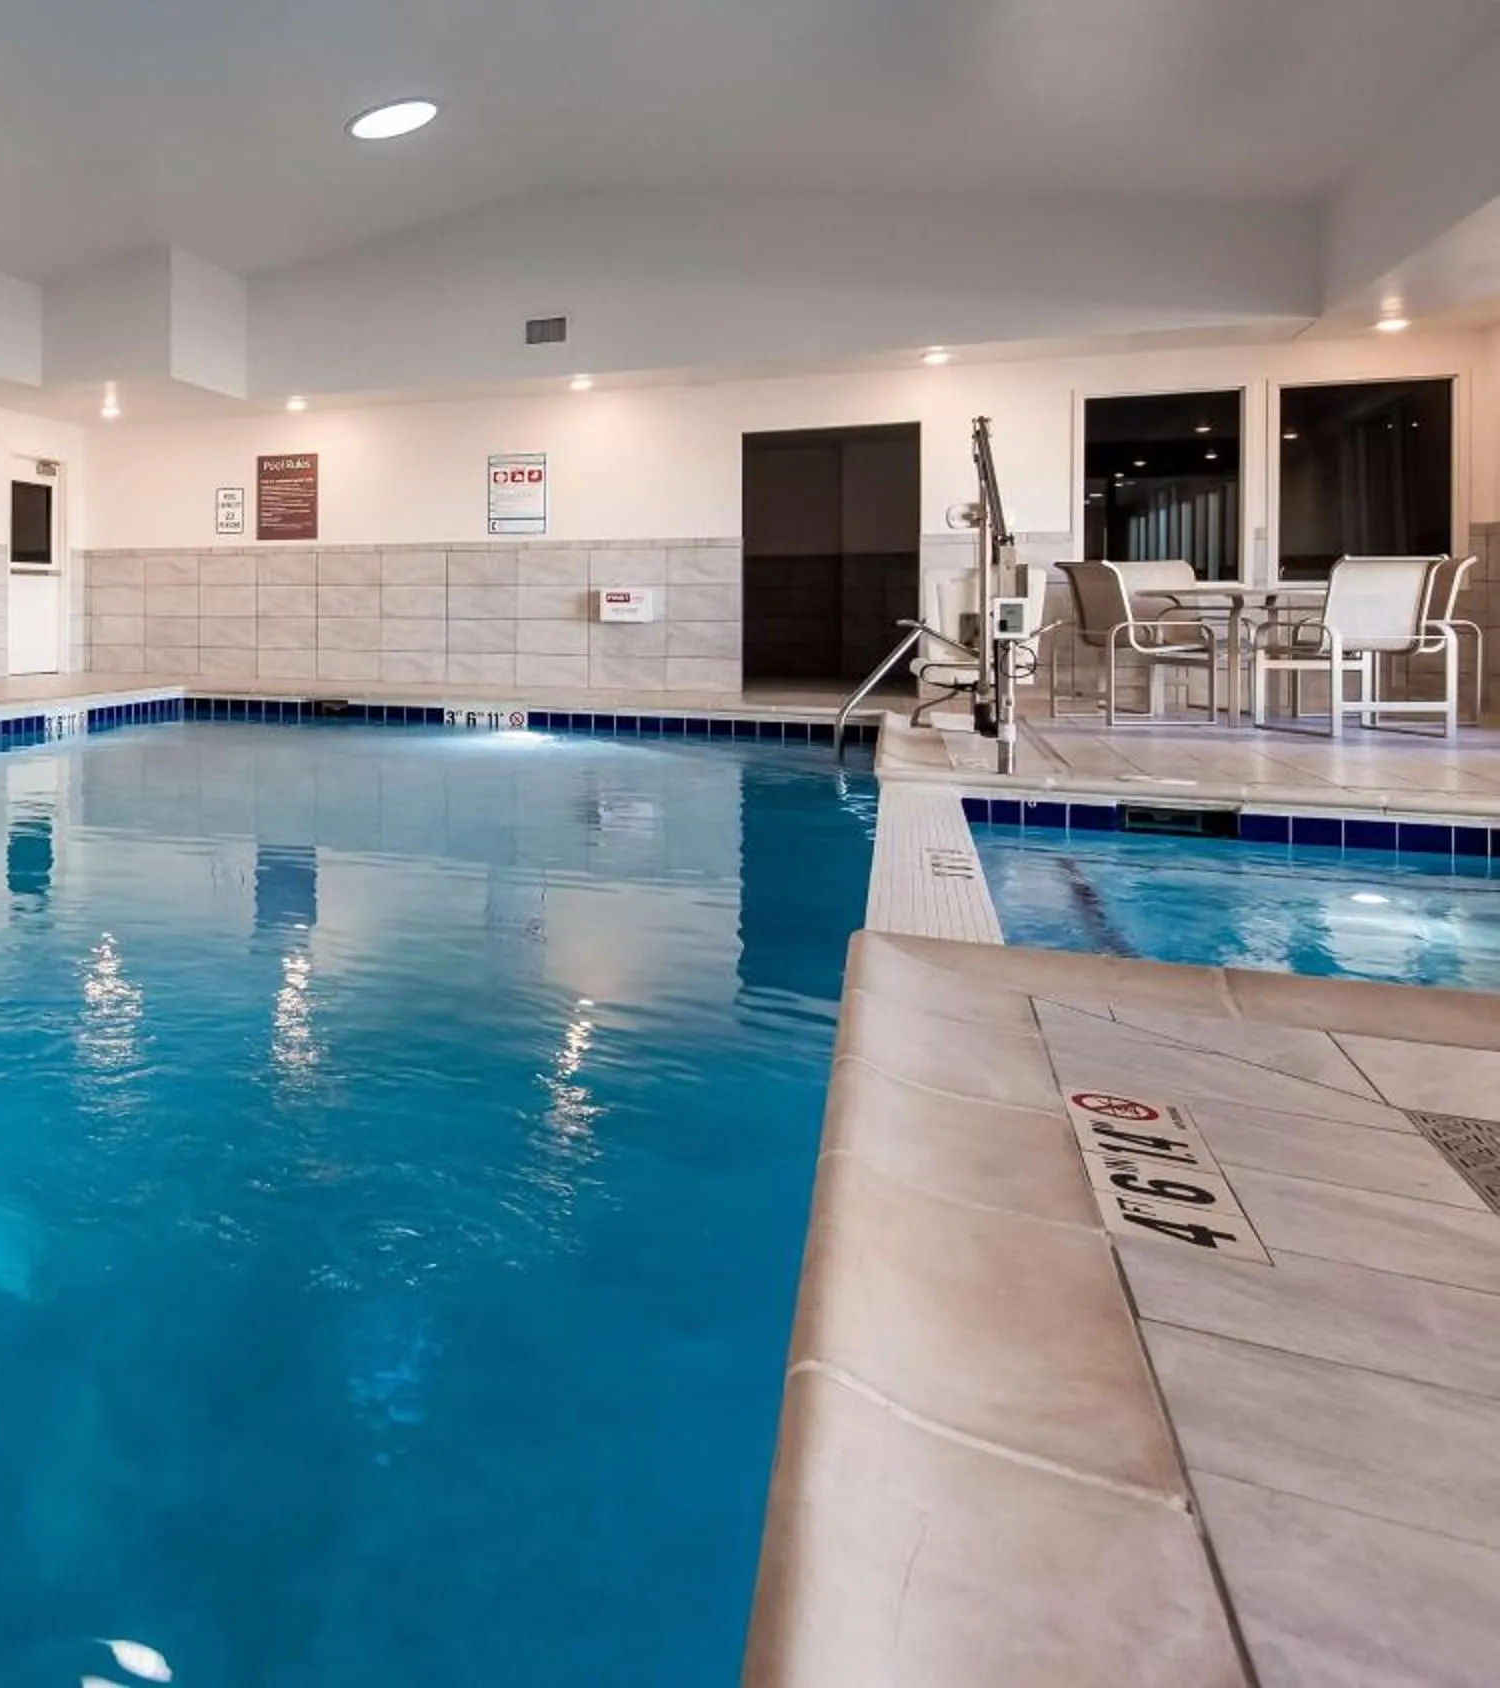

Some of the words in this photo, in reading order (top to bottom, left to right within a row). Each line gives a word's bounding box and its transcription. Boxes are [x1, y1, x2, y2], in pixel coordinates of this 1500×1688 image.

[263, 460, 284, 471] Pool
[285, 458, 311, 469] Rules
[1110, 1173, 1216, 1205] 6
[1123, 1213, 1237, 1248] 4
